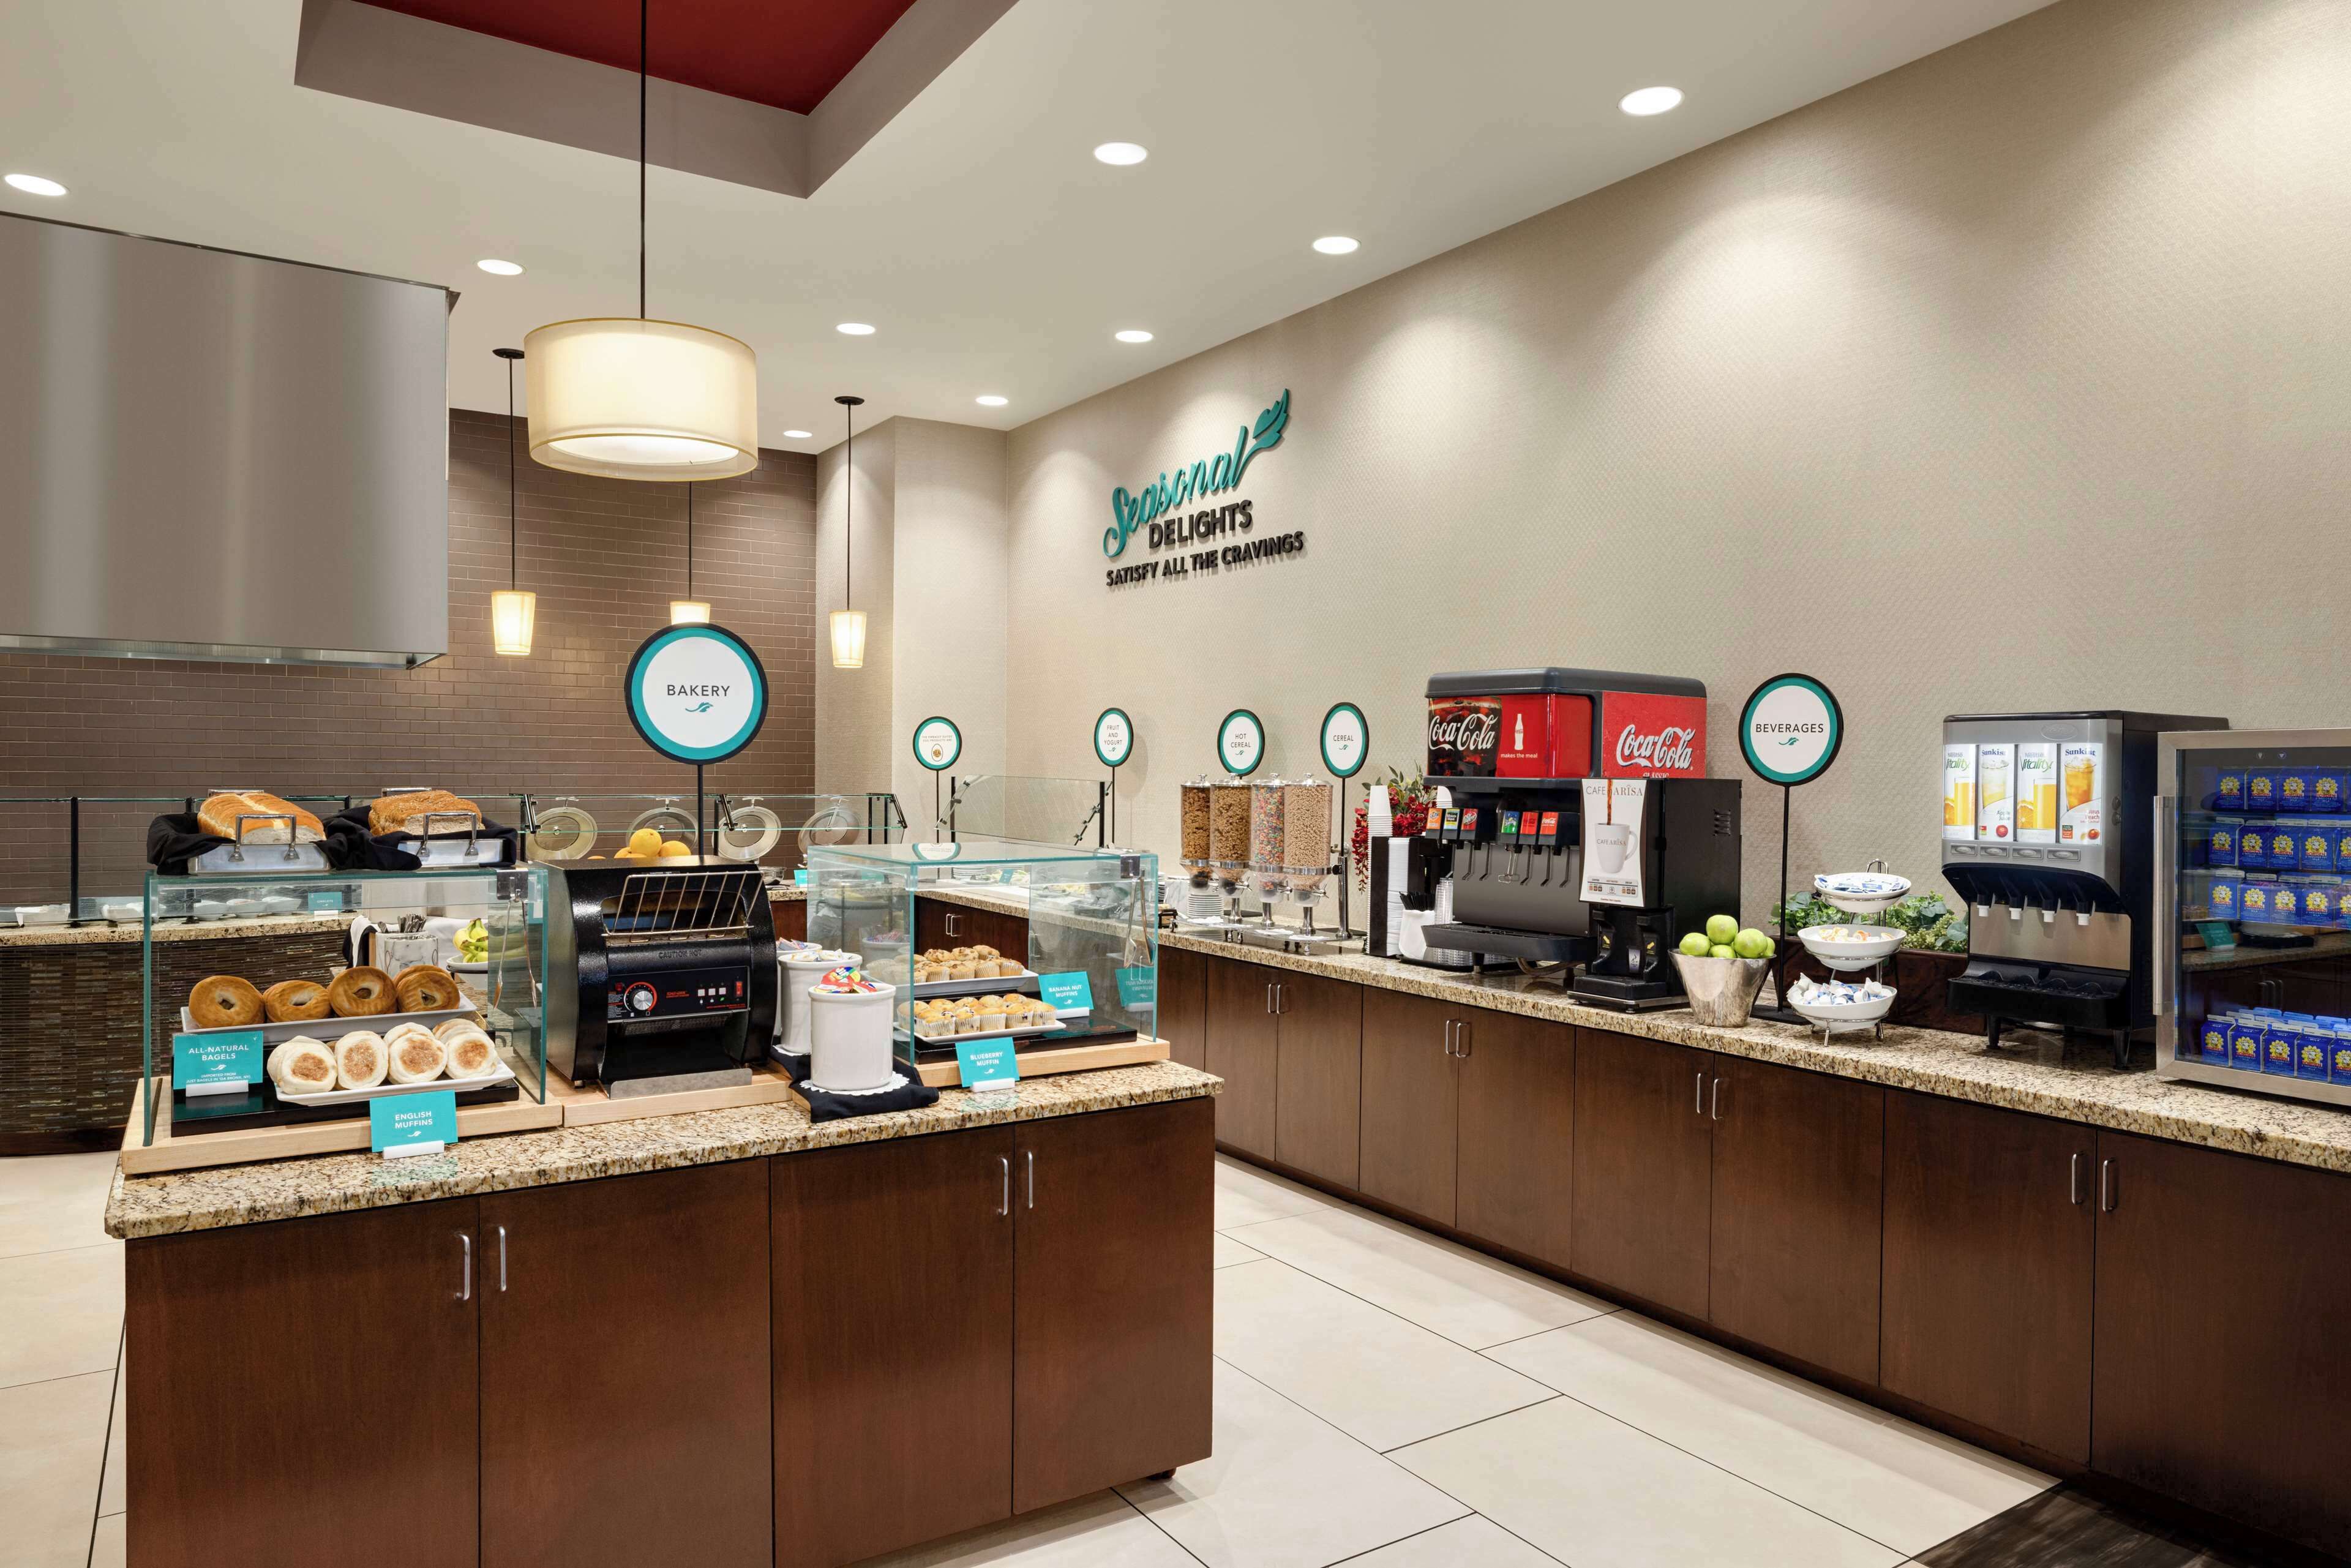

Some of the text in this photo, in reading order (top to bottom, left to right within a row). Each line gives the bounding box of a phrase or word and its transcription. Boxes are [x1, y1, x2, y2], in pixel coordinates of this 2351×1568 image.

[1103, 424, 1251, 558] Seasonal
[1149, 500, 1253, 549] DELIGHTS
[1106, 530, 1304, 587] SATISFY ALL THE CRAVINGS
[667, 685, 730, 697] BAKERY
[1428, 713, 1498, 751] Coca-Cola
[1755, 723, 1824, 733] BEVERAGES
[1616, 724, 1696, 769] Coca-Cola
[1586, 786, 1606, 795] CAFE
[658, 950, 687, 959] CAUTION
[189, 1045, 249, 1054] ALL-NATURAL
[201, 1052, 236, 1061] BAGELS
[970, 1051, 1003, 1060] BLUEBERRY
[395, 1111, 432, 1120] ENGLISH
[395, 1119, 433, 1129] MUFFINS
